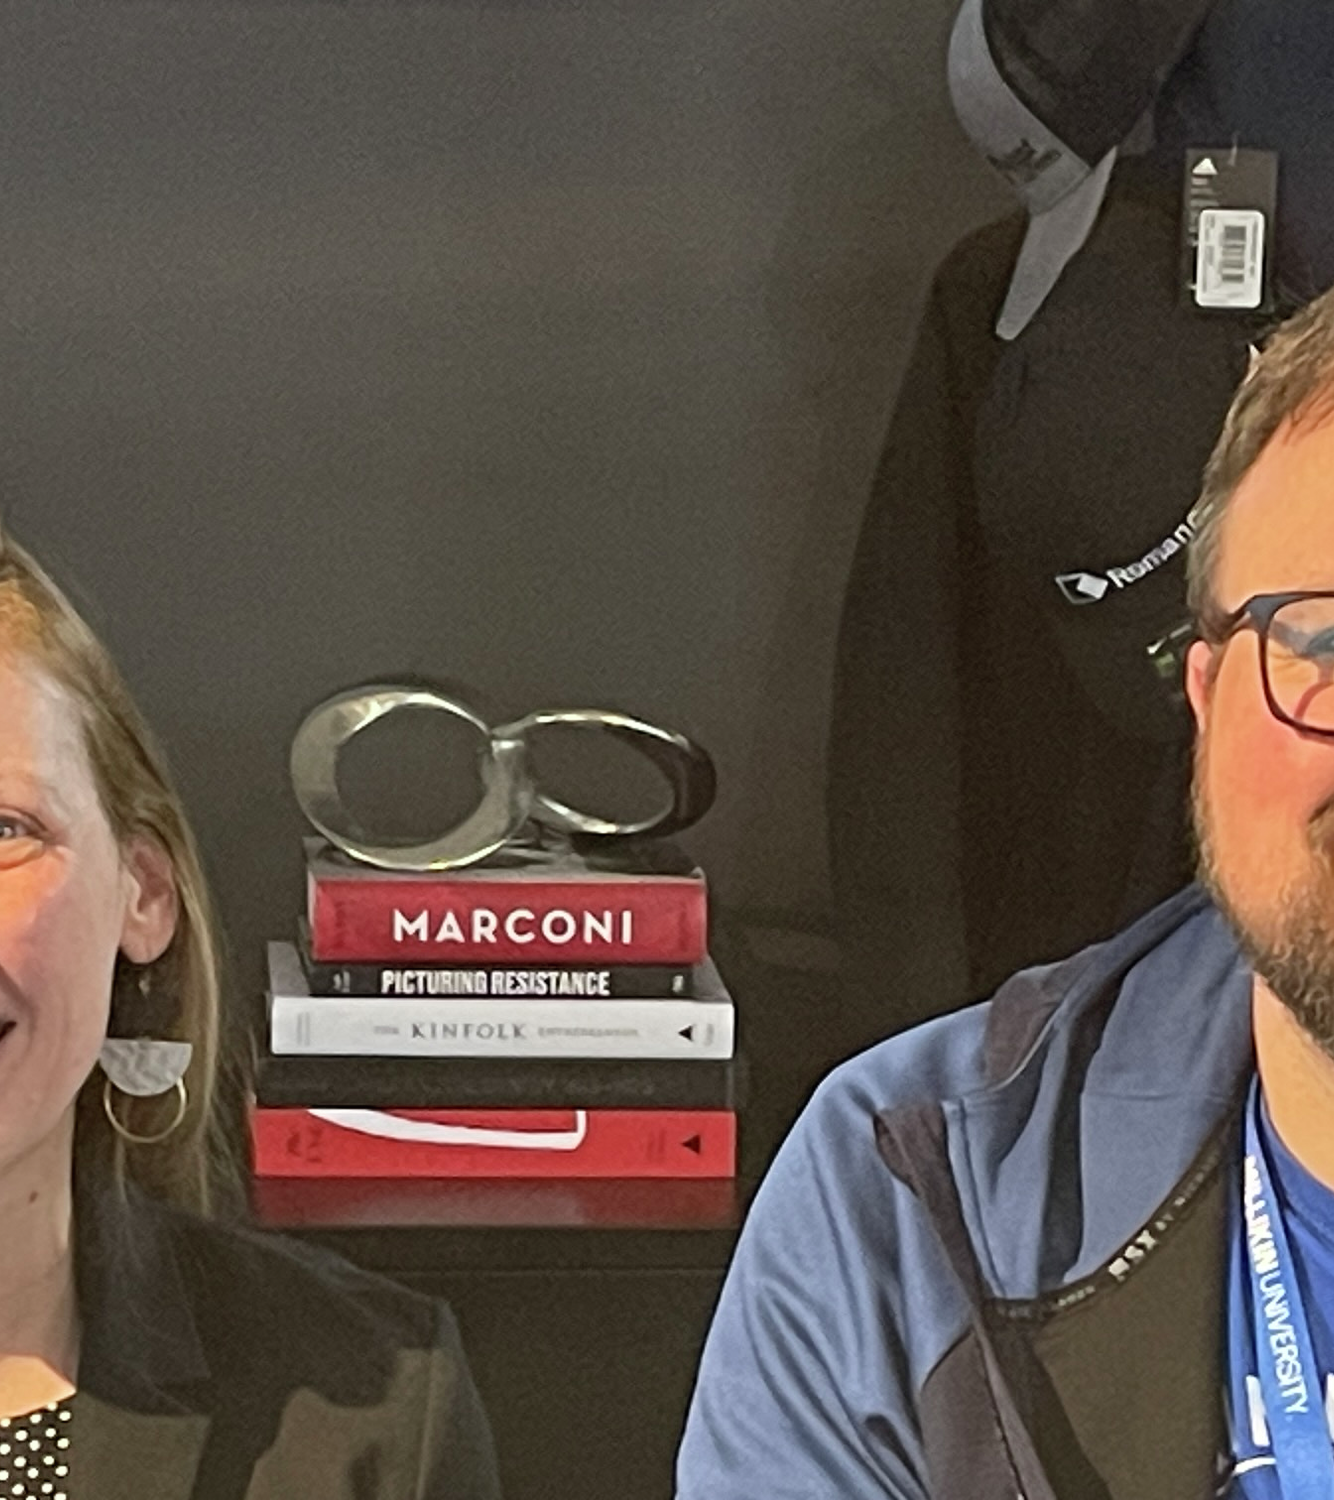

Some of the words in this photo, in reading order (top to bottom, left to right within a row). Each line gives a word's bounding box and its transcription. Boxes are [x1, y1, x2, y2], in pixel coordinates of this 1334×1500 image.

[392, 909, 632, 944] MARCONI
[381, 970, 487, 995] PICTURING
[491, 971, 611, 996] RESISTANCE
[411, 1023, 527, 1040] KINFOLK
[1258, 1272, 1308, 1413] UNIVERSITY
